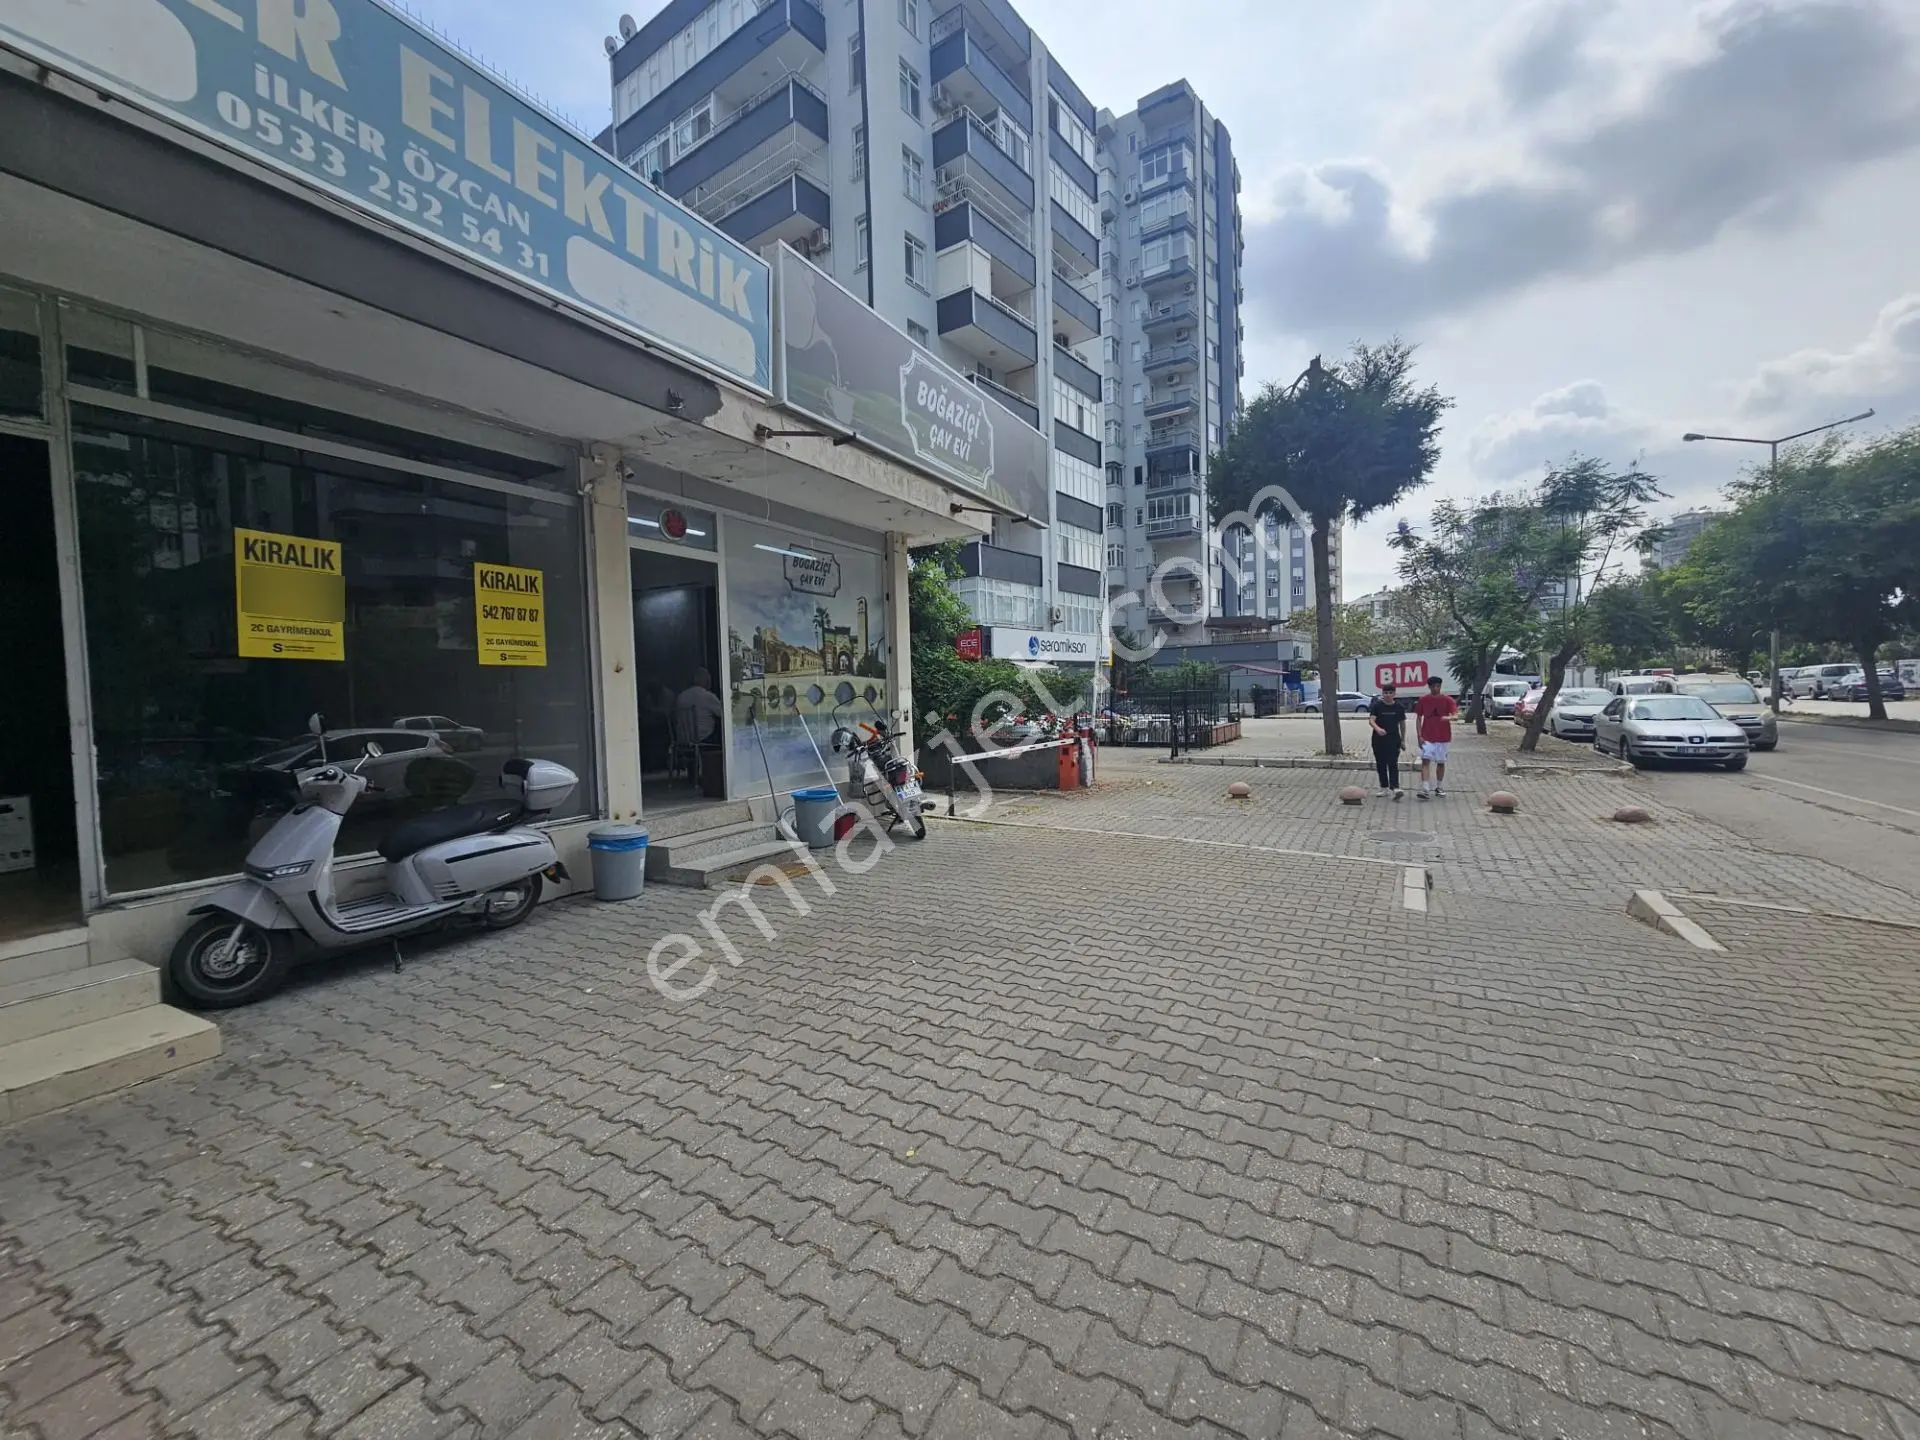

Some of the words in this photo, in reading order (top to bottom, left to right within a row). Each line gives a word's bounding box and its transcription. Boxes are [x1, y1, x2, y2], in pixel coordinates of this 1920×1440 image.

[217, 91, 347, 177] 0533
[368, 165, 444, 227] 252
[460, 212, 503, 255] 54
[516, 240, 549, 278] 31
[403, 141, 530, 236] ÖZCAN
[917, 380, 982, 442] BOĞAZİÇİ
[929, 424, 952, 450] ÇAY
[483, 605, 499, 620] 542
[500, 606, 515, 621] 767
[1040, 638, 1087, 653] seramiksan
